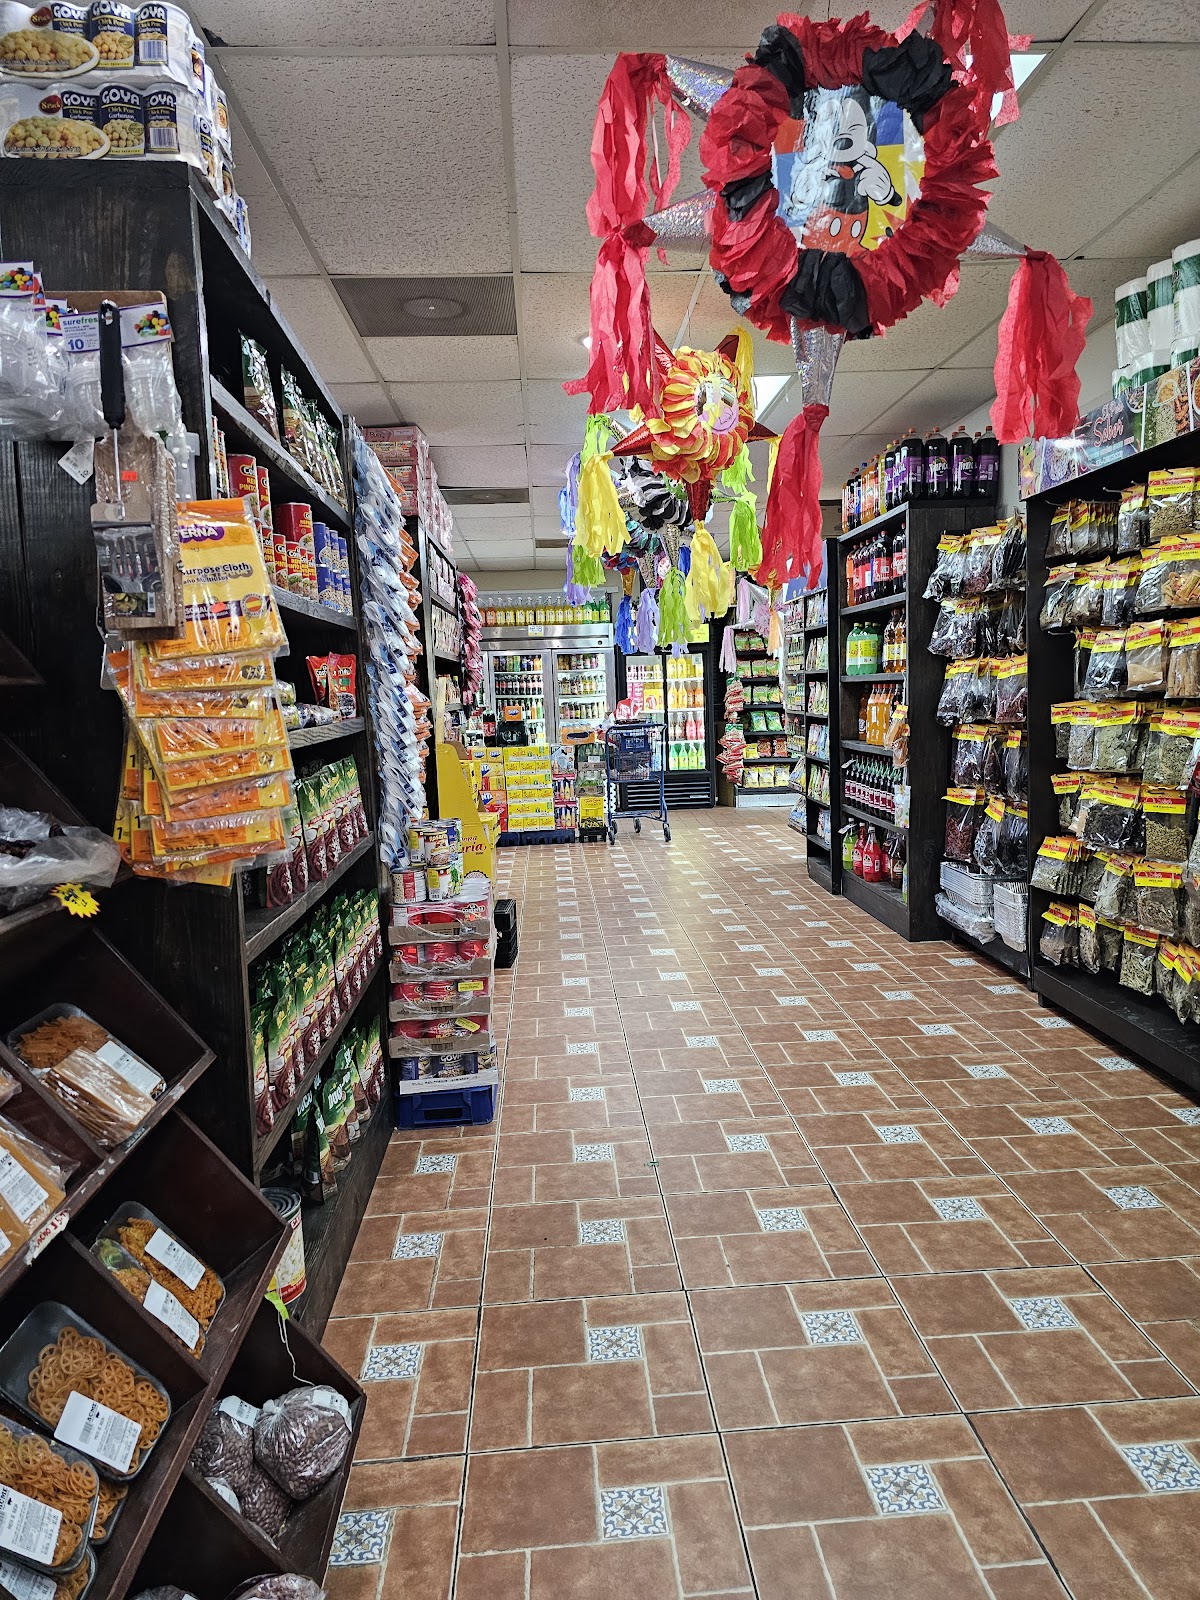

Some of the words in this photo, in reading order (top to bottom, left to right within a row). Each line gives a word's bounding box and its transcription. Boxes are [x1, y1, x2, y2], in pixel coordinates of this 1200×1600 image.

[92, 0, 131, 20] GOYA
[102, 88, 140, 106] GOYA
[63, 316, 98, 326] surefres
[68, 339, 84, 350] 10
[222, 562, 249, 573] Cloth
[116, 827, 123, 840] 1
[87, 1402, 97, 1421] ACME
